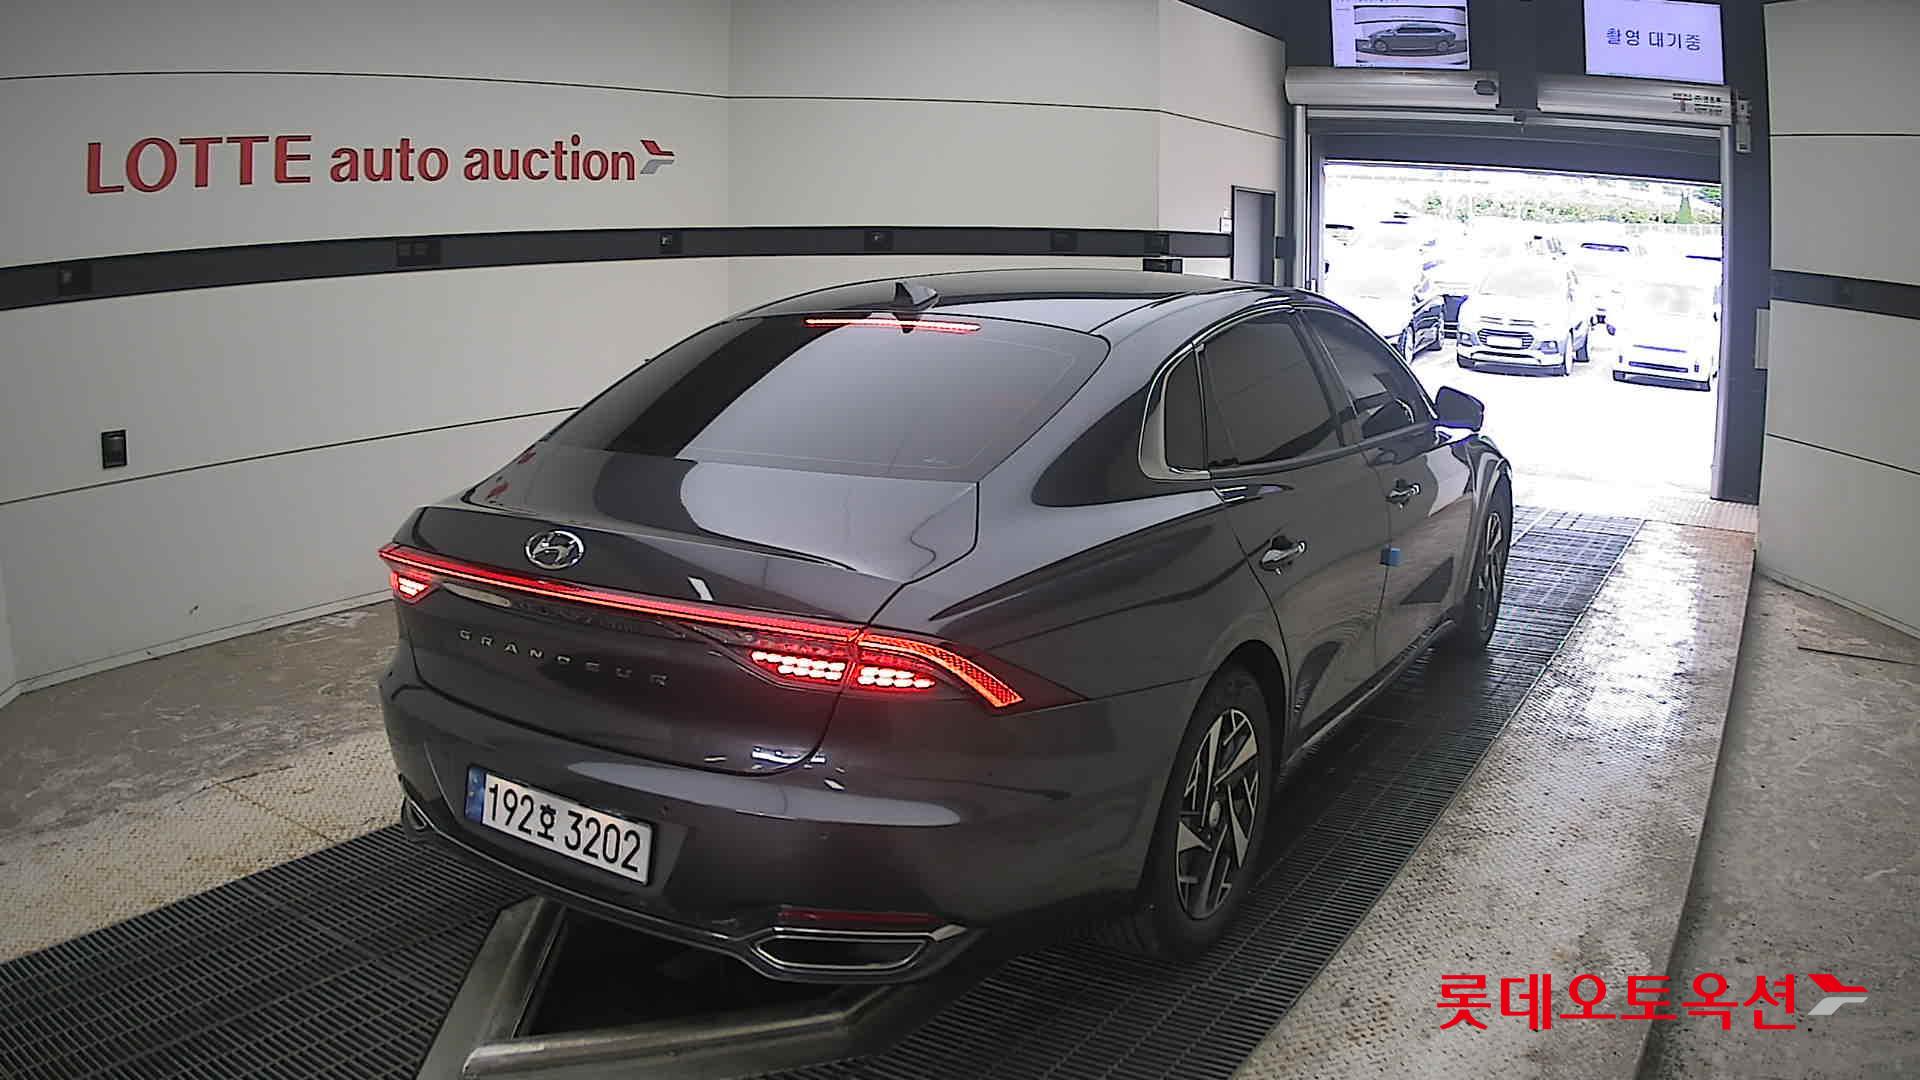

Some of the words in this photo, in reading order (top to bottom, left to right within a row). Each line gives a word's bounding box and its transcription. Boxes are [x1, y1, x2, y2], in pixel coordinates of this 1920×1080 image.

[1648, 31, 1701, 52] 대기중
[86, 135, 312, 195] LOTTE
[329, 137, 449, 183] auto
[463, 133, 637, 182] auction
[489, 783, 558, 843] 192호
[564, 809, 641, 874] 3202
